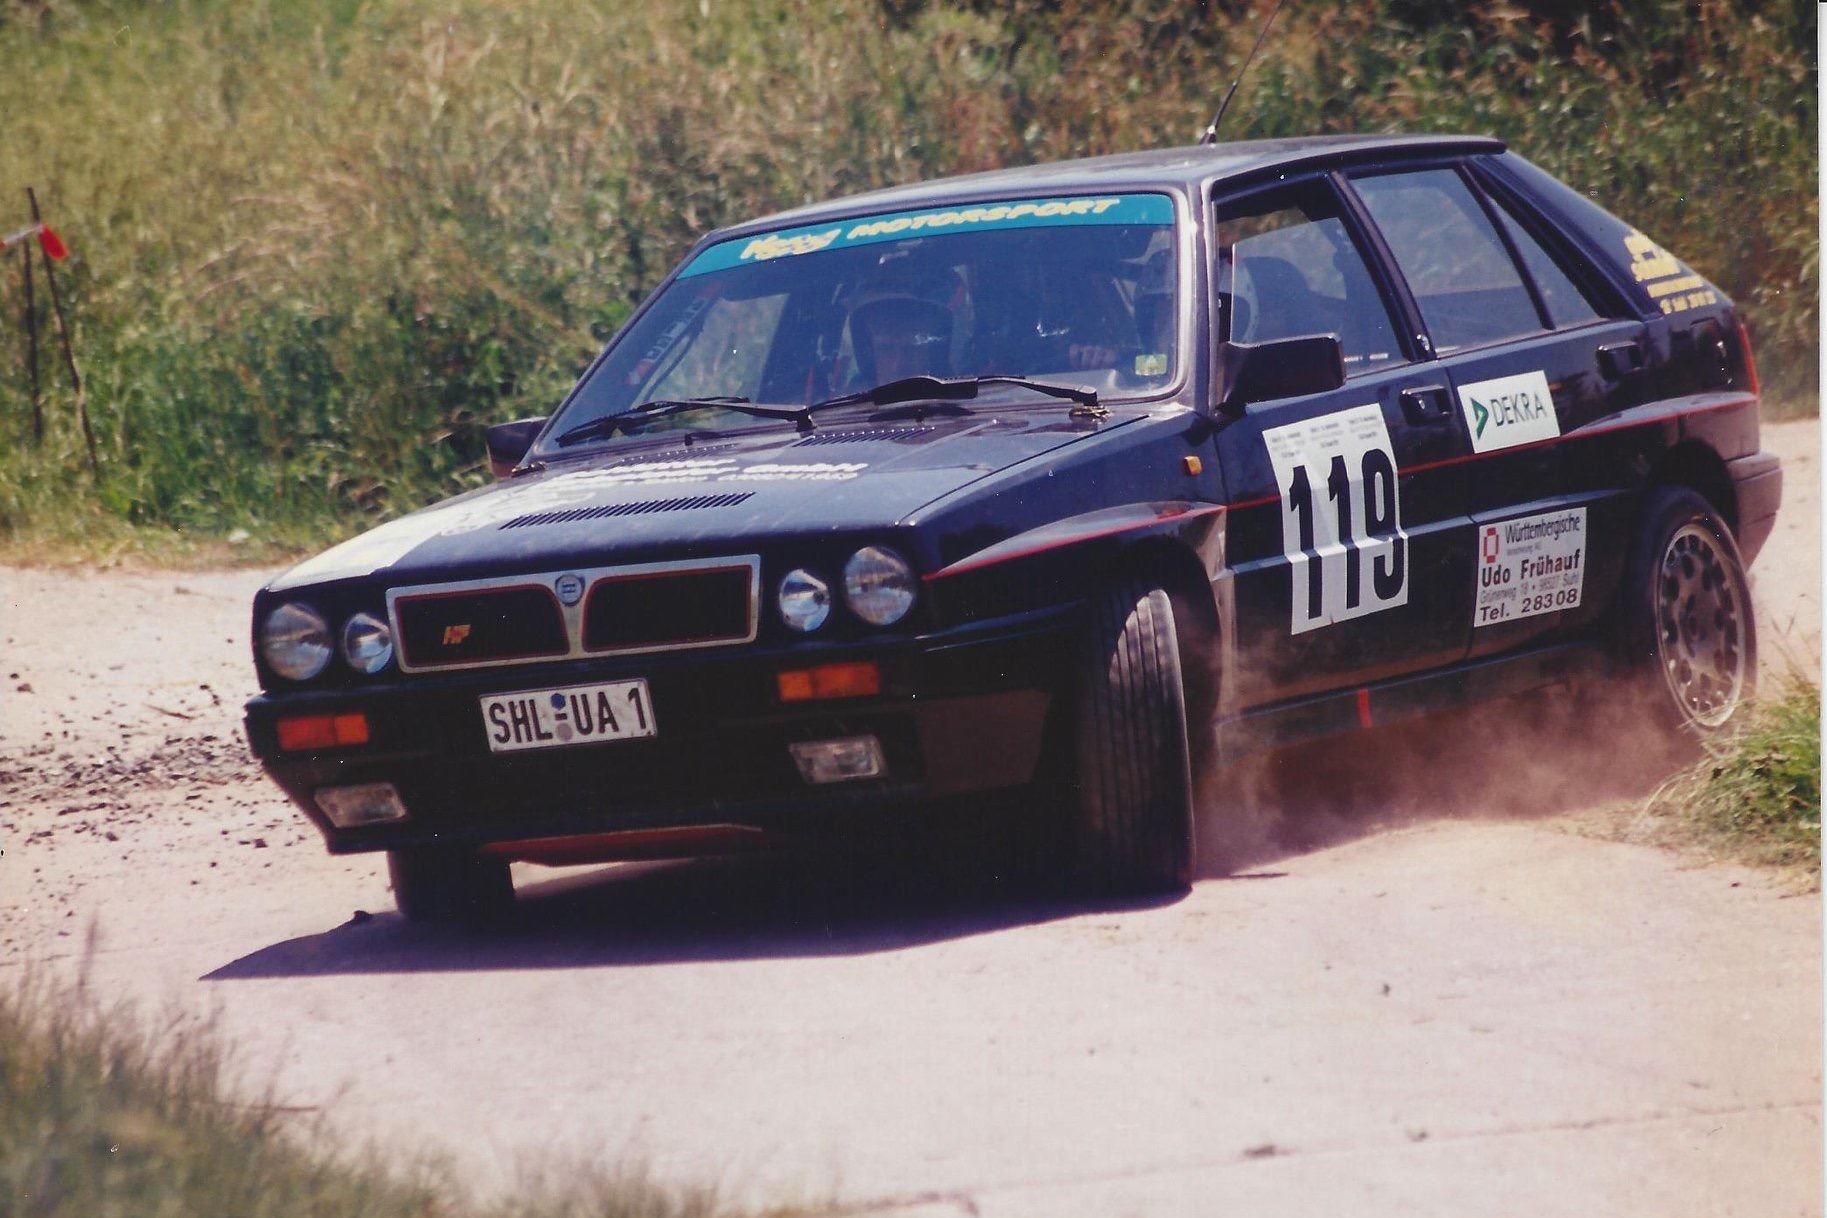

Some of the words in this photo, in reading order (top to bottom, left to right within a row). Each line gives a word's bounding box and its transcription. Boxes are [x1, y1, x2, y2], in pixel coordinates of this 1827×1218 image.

[847, 198, 1120, 239] MOTORSPORT
[1490, 392, 1547, 427] DEKRA
[1289, 448, 1405, 619] 119
[1505, 513, 1580, 543] Württembergische
[1482, 564, 1511, 588] Udo
[1520, 548, 1581, 579] Frühauf
[1480, 602, 1511, 622] Tel.
[1521, 588, 1578, 613] 28308
[627, 687, 647, 730] 1
